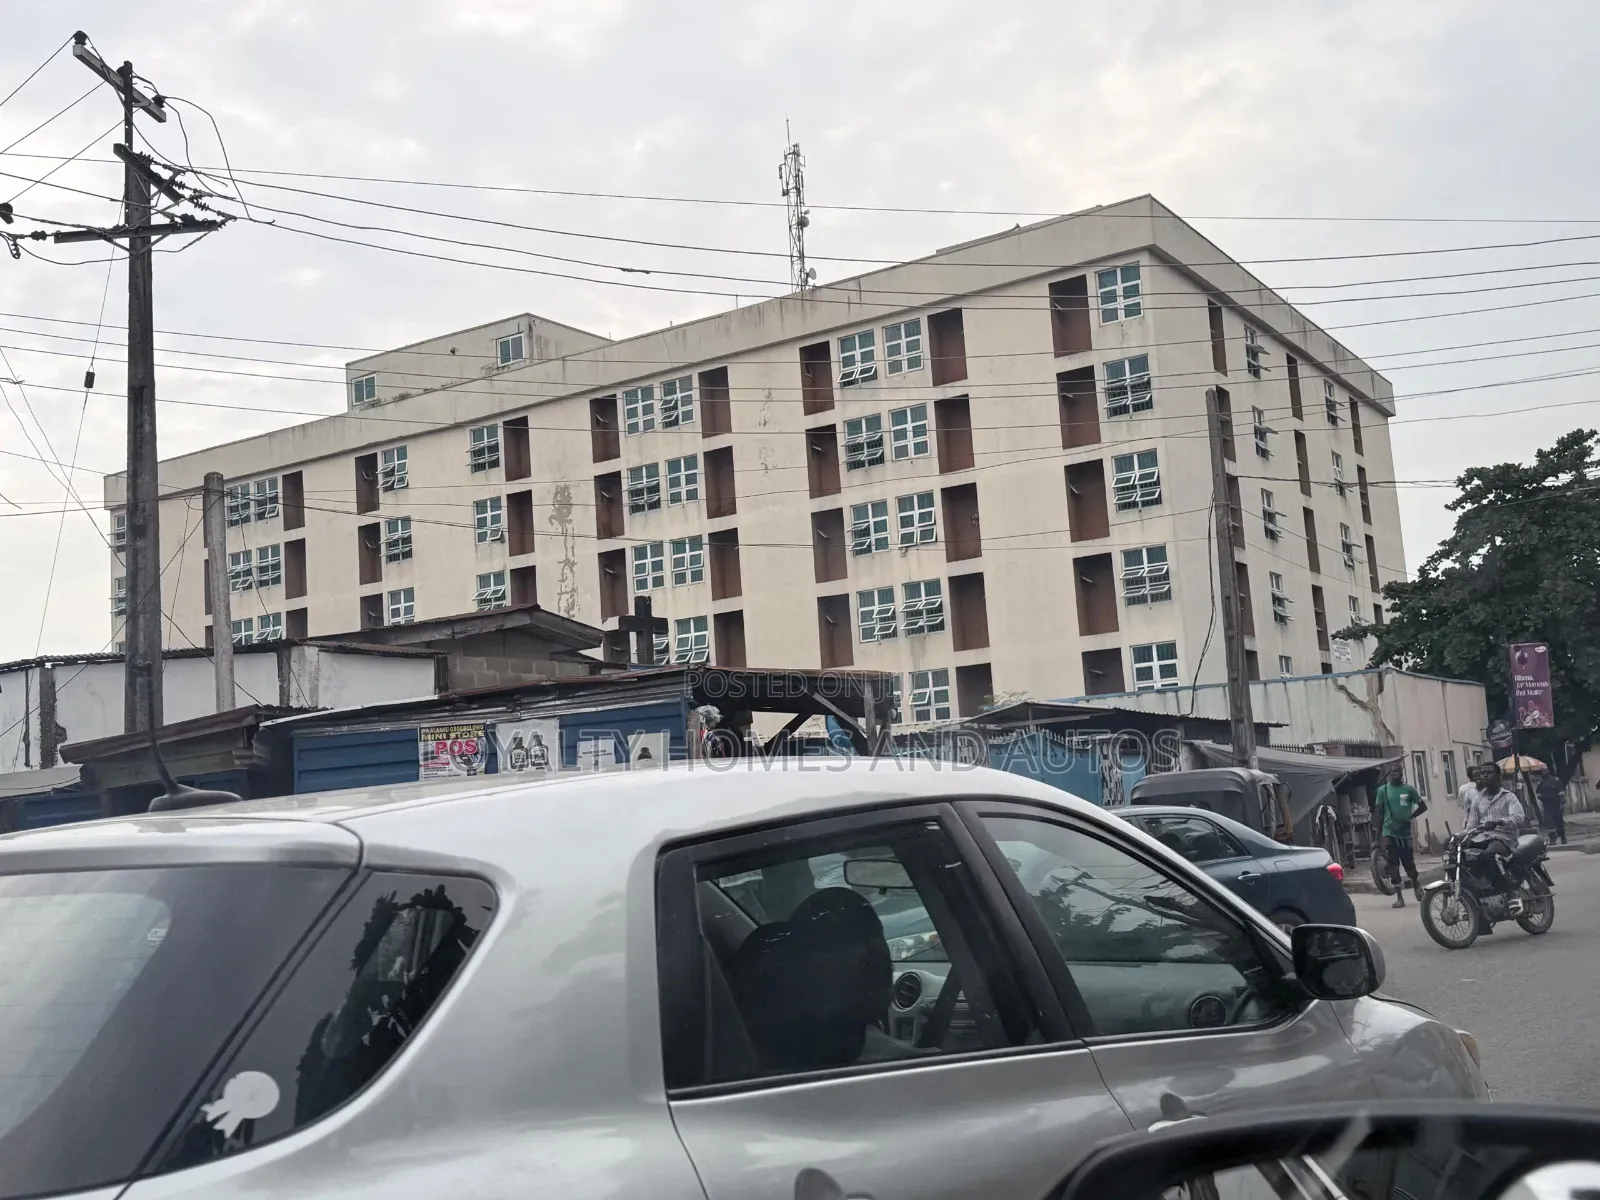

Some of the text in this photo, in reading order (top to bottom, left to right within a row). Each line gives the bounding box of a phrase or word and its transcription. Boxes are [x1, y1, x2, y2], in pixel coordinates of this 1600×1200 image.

[421, 731, 485, 741] MINI STORE
[434, 739, 477, 756] POS
